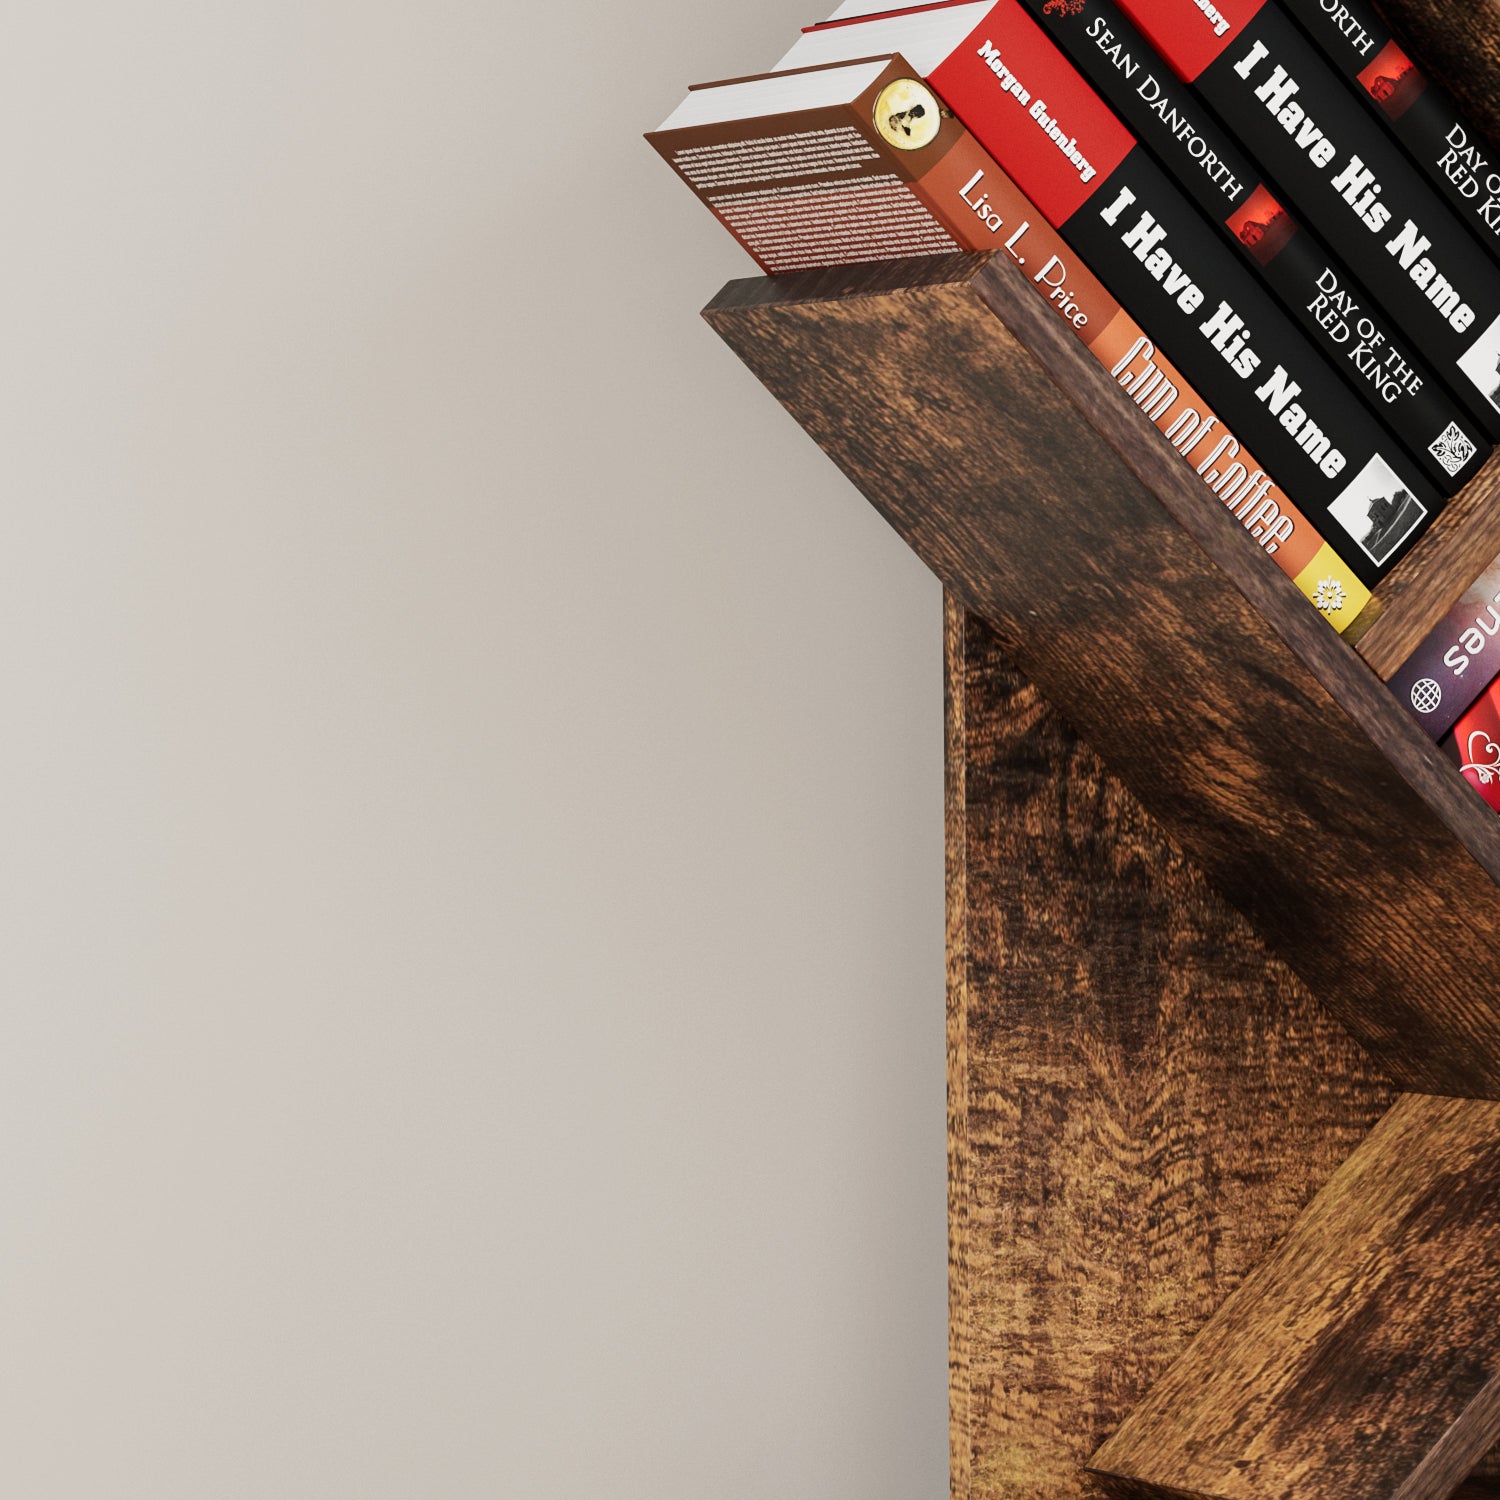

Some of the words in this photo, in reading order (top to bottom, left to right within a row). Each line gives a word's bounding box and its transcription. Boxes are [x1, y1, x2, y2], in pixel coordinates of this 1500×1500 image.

[976, 39, 1031, 107] Morgan
[1028, 99, 1097, 183] Gutenberg
[1085, 16, 1141, 79] SEAN
[1136, 74, 1244, 202] DANFORTH
[1436, 148, 1480, 199] RED
[1444, 122, 1489, 174] DAY
[958, 168, 1004, 233] Lisa
[1003, 220, 1030, 266] L.
[1033, 254, 1089, 329] Price
[1232, 39, 1270, 81] I
[1253, 64, 1336, 169] Have
[1330, 154, 1392, 233] His
[1384, 218, 1476, 334] Name
[1099, 185, 1137, 227] I
[1120, 209, 1205, 315] Have
[1198, 300, 1262, 379] His
[1254, 364, 1347, 479] Name
[1306, 292, 1350, 343] RED
[1347, 339, 1402, 404] KING
[1315, 266, 1359, 318] DAY
[1356, 317, 1386, 349] OF
[1384, 346, 1424, 396] THE
[1164, 407, 1220, 458] of
[1196, 434, 1295, 555] Coffee
